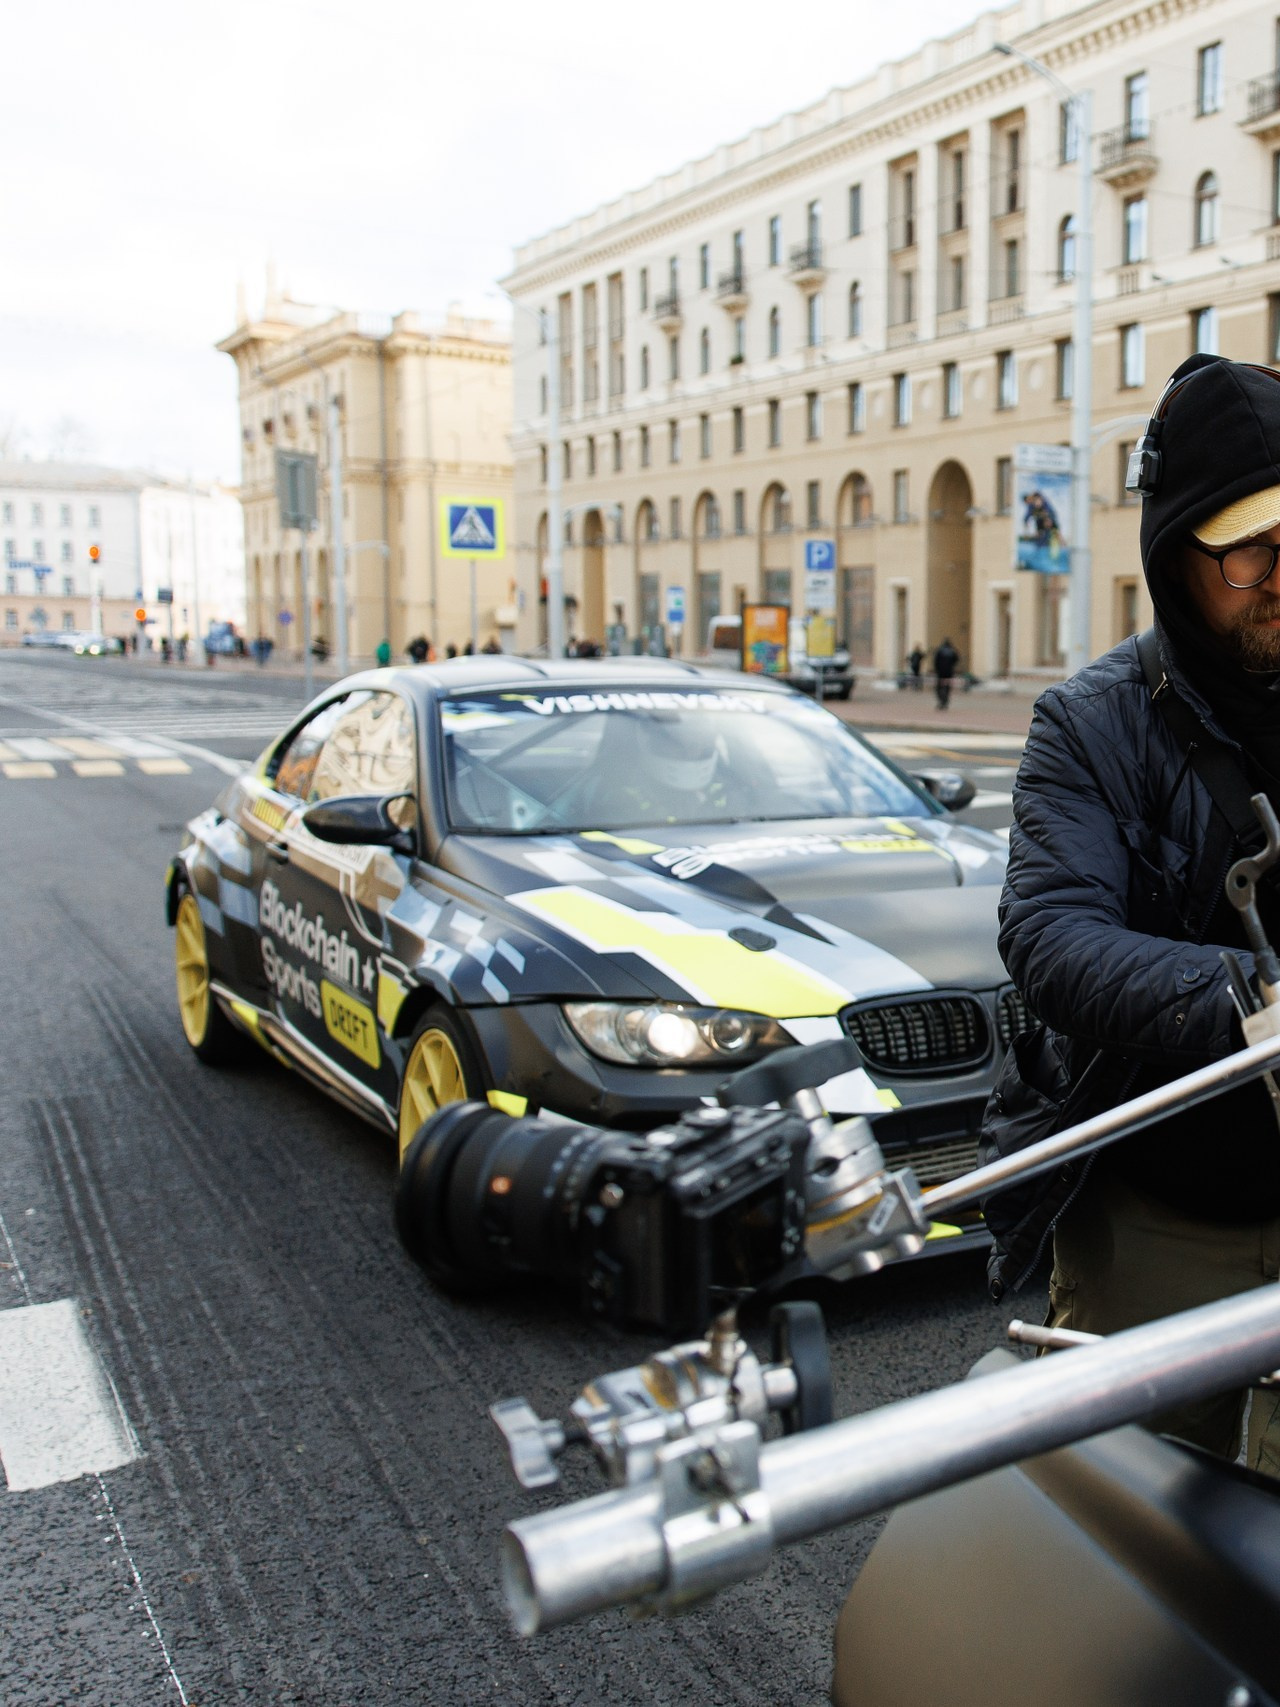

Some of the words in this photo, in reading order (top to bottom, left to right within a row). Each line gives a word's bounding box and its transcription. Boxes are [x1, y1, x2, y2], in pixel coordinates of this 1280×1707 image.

[810, 541, 829, 568] P
[523, 693, 766, 715] VISHNEVSKY
[259, 878, 359, 988] Blockchain
[260, 935, 322, 1019] Sports
[330, 997, 369, 1049] DRIFT
